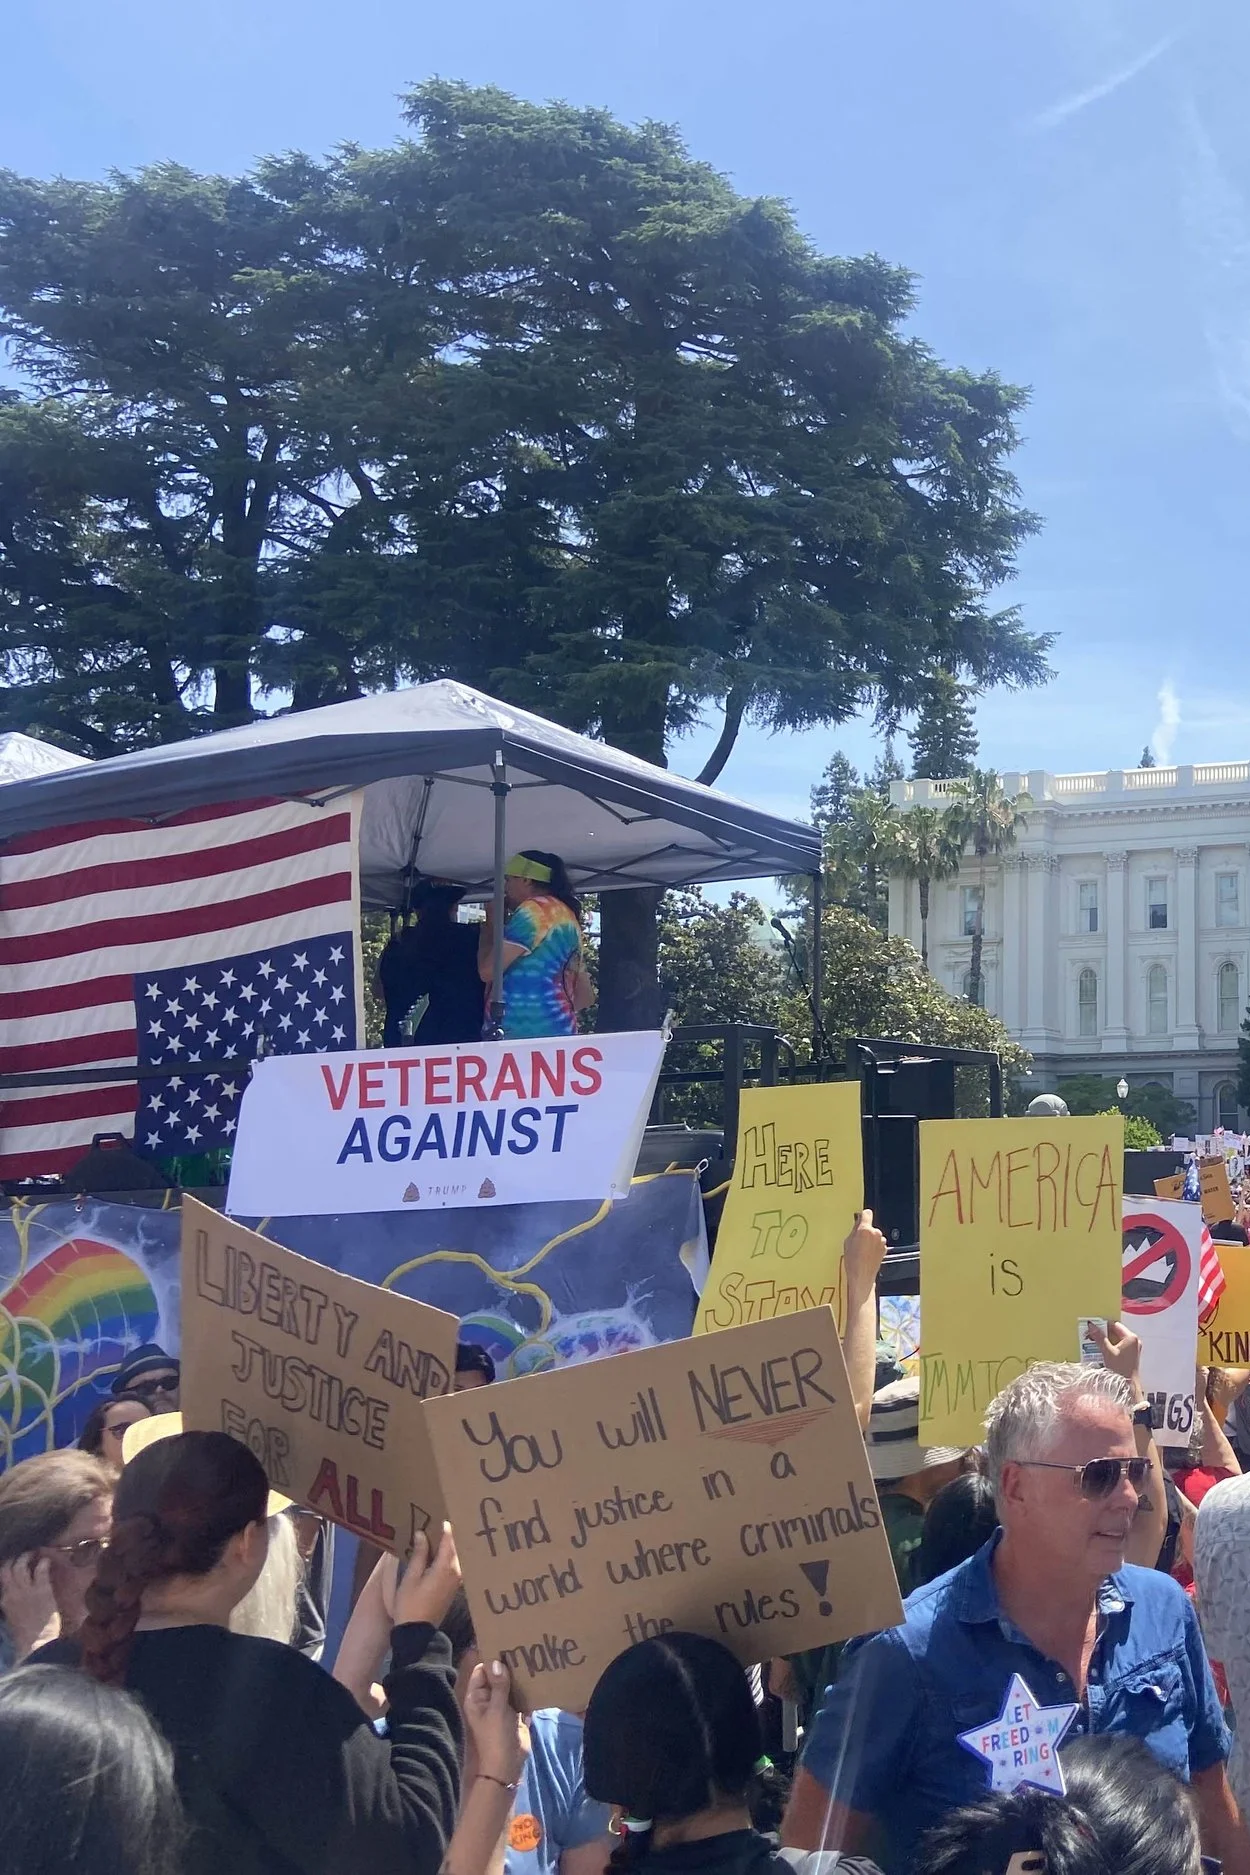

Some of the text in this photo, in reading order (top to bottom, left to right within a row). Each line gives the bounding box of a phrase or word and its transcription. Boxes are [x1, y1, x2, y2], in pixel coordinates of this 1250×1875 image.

[320, 1047, 604, 1111] VETERANS
[336, 1104, 578, 1165] AGAINST
[741, 1122, 834, 1193] HERE
[427, 1184, 468, 1197] TRUMP
[928, 1142, 1118, 1233] AMERICA
[751, 1209, 809, 1259] TO
[196, 1229, 451, 1399] LIBERTY AND
[231, 1331, 389, 1450] JUSTICE
[597, 1387, 668, 1450] will
[688, 1347, 836, 1432] NEVER
[1147, 1391, 1195, 1433] NGS
[475, 1450, 796, 1557] find justice in a
[484, 1482, 881, 1615] world where criminals
[500, 1634, 587, 1678] make
[982, 1718, 1059, 1754] FREEDM
[1006, 1703, 1032, 1725] LET
[1013, 1743, 1050, 1767] RING
